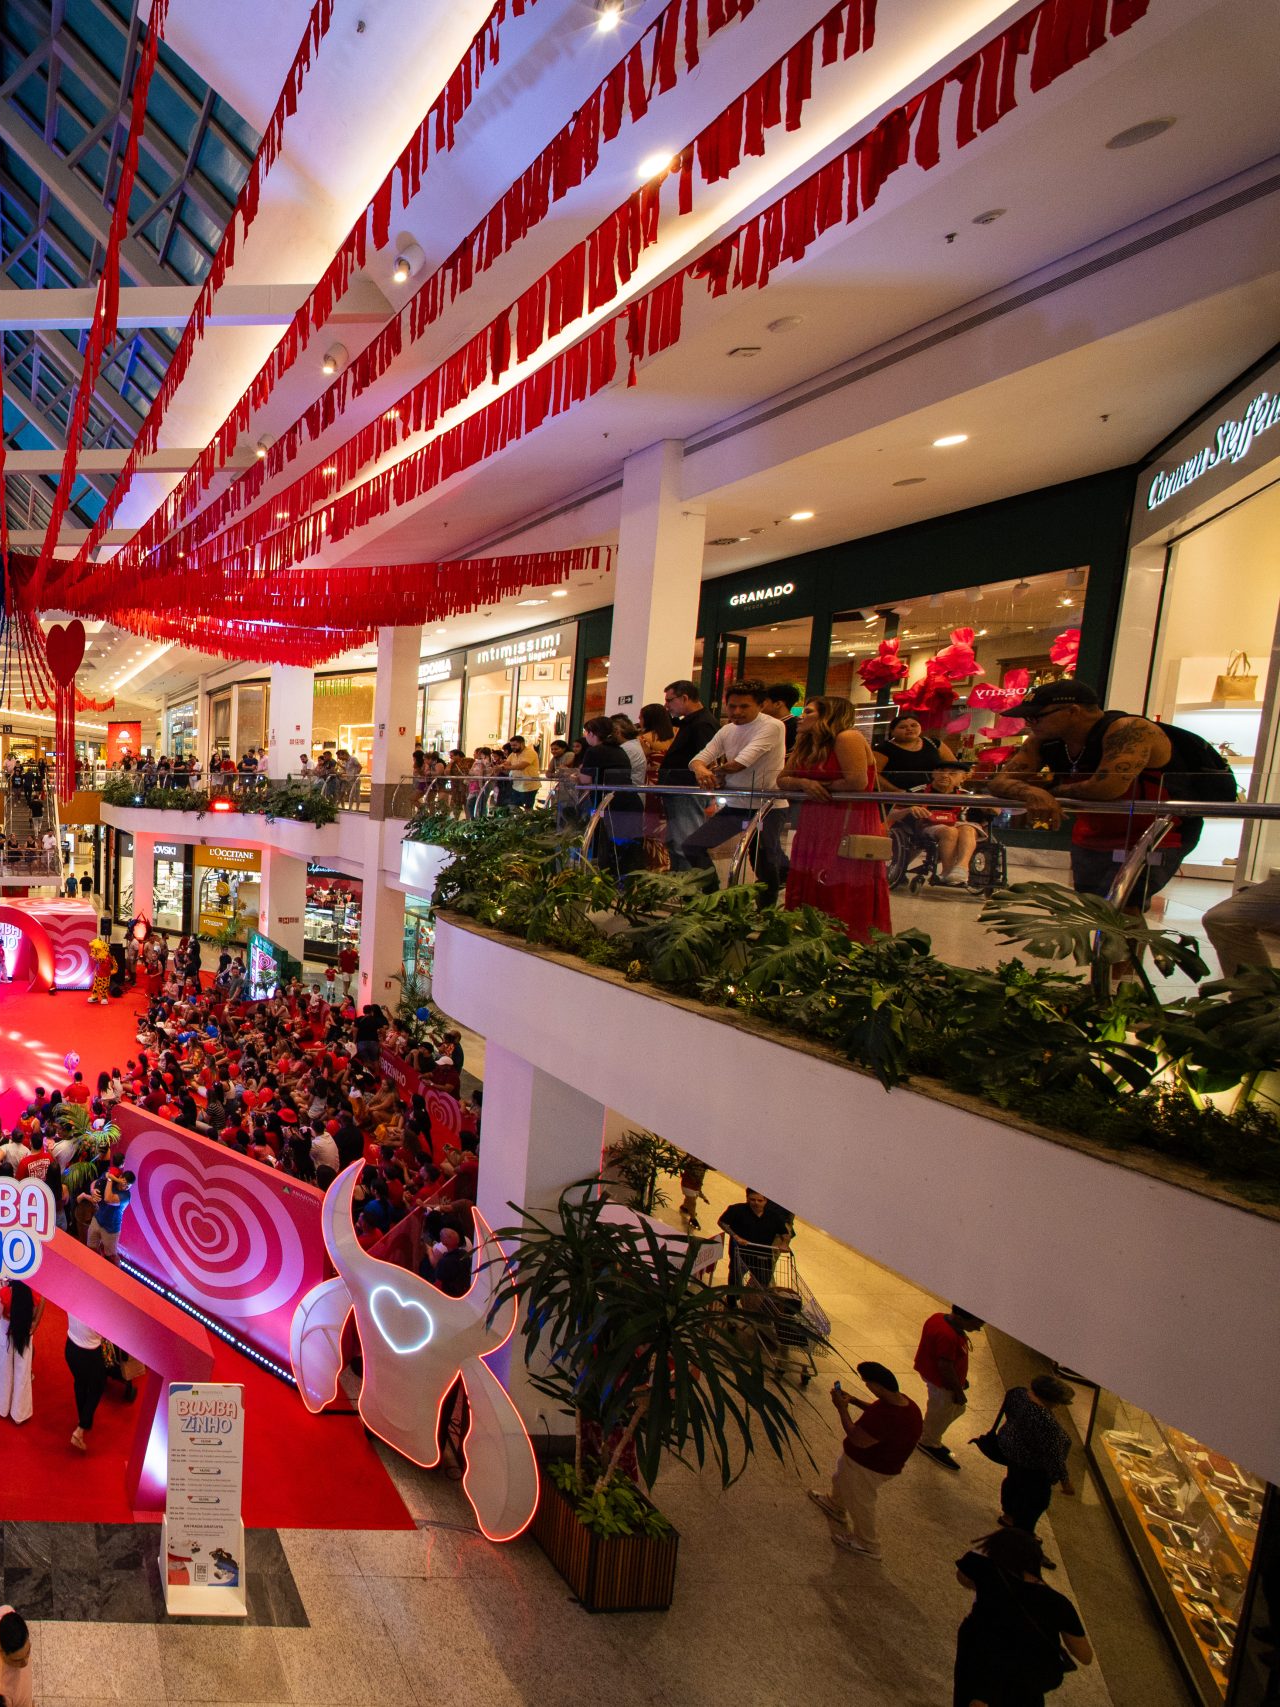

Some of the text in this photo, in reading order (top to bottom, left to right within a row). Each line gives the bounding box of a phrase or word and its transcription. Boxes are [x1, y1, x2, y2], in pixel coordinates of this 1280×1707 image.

[1207, 392, 1280, 469] Steffen
[729, 582, 794, 606] GRANADO
[209, 848, 255, 860] L'OCCITANE
[176, 1398, 238, 1420] BUMBA
